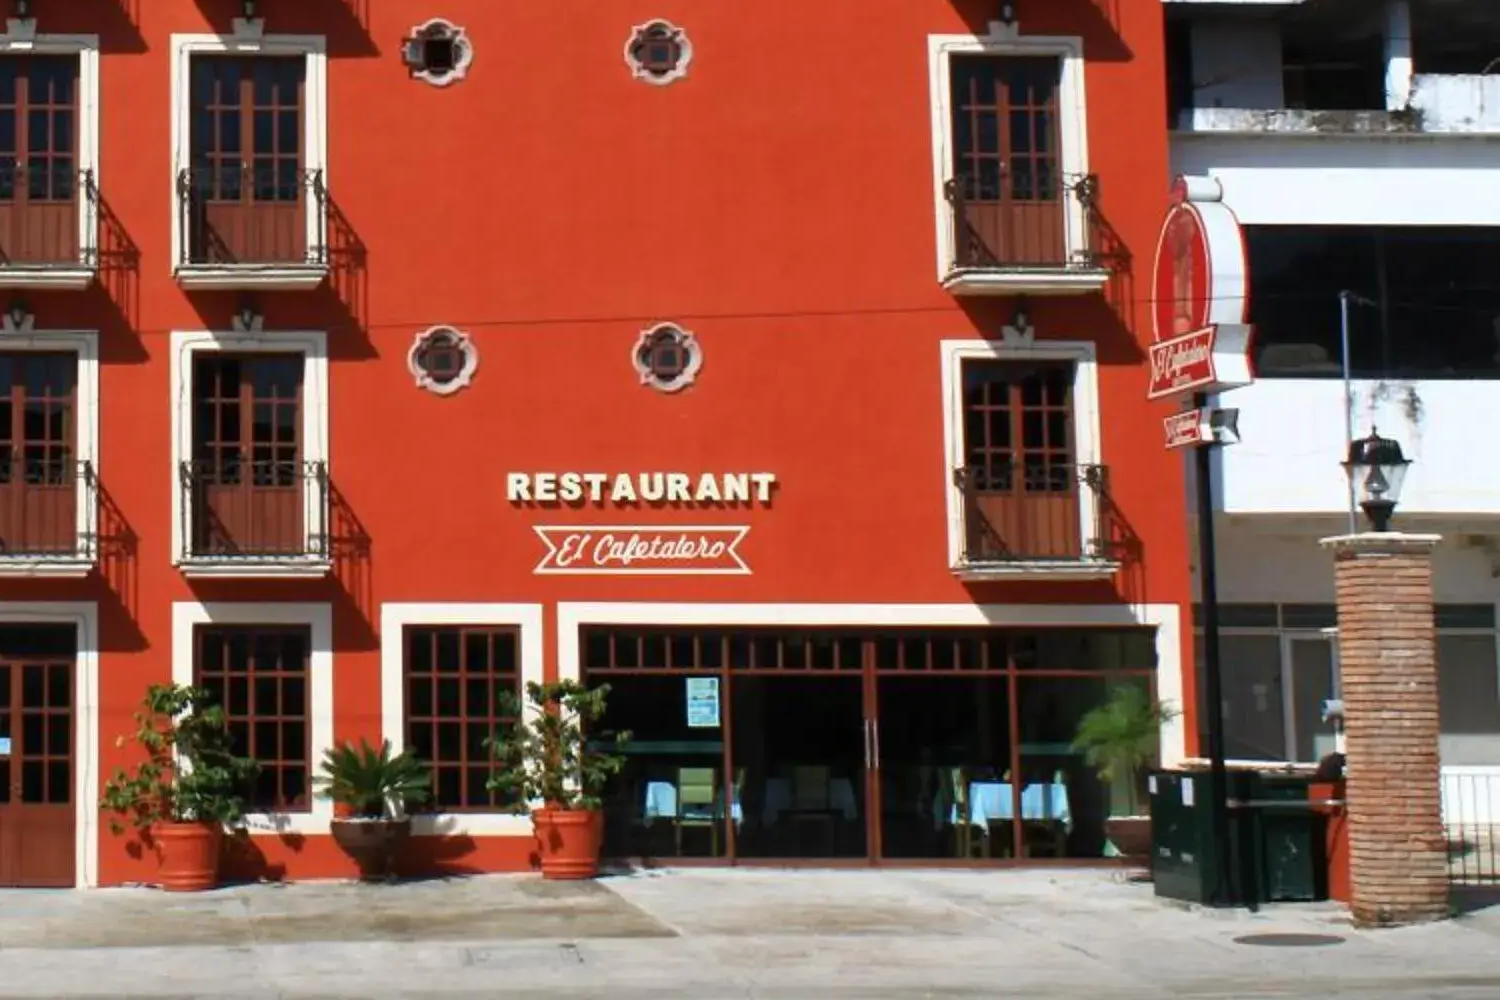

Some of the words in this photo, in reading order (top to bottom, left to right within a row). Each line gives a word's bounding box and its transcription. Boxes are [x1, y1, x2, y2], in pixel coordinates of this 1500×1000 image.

[506, 472, 777, 502] RESTAURANT
[555, 534, 592, 567] El
[592, 533, 726, 566] Cafetalero
